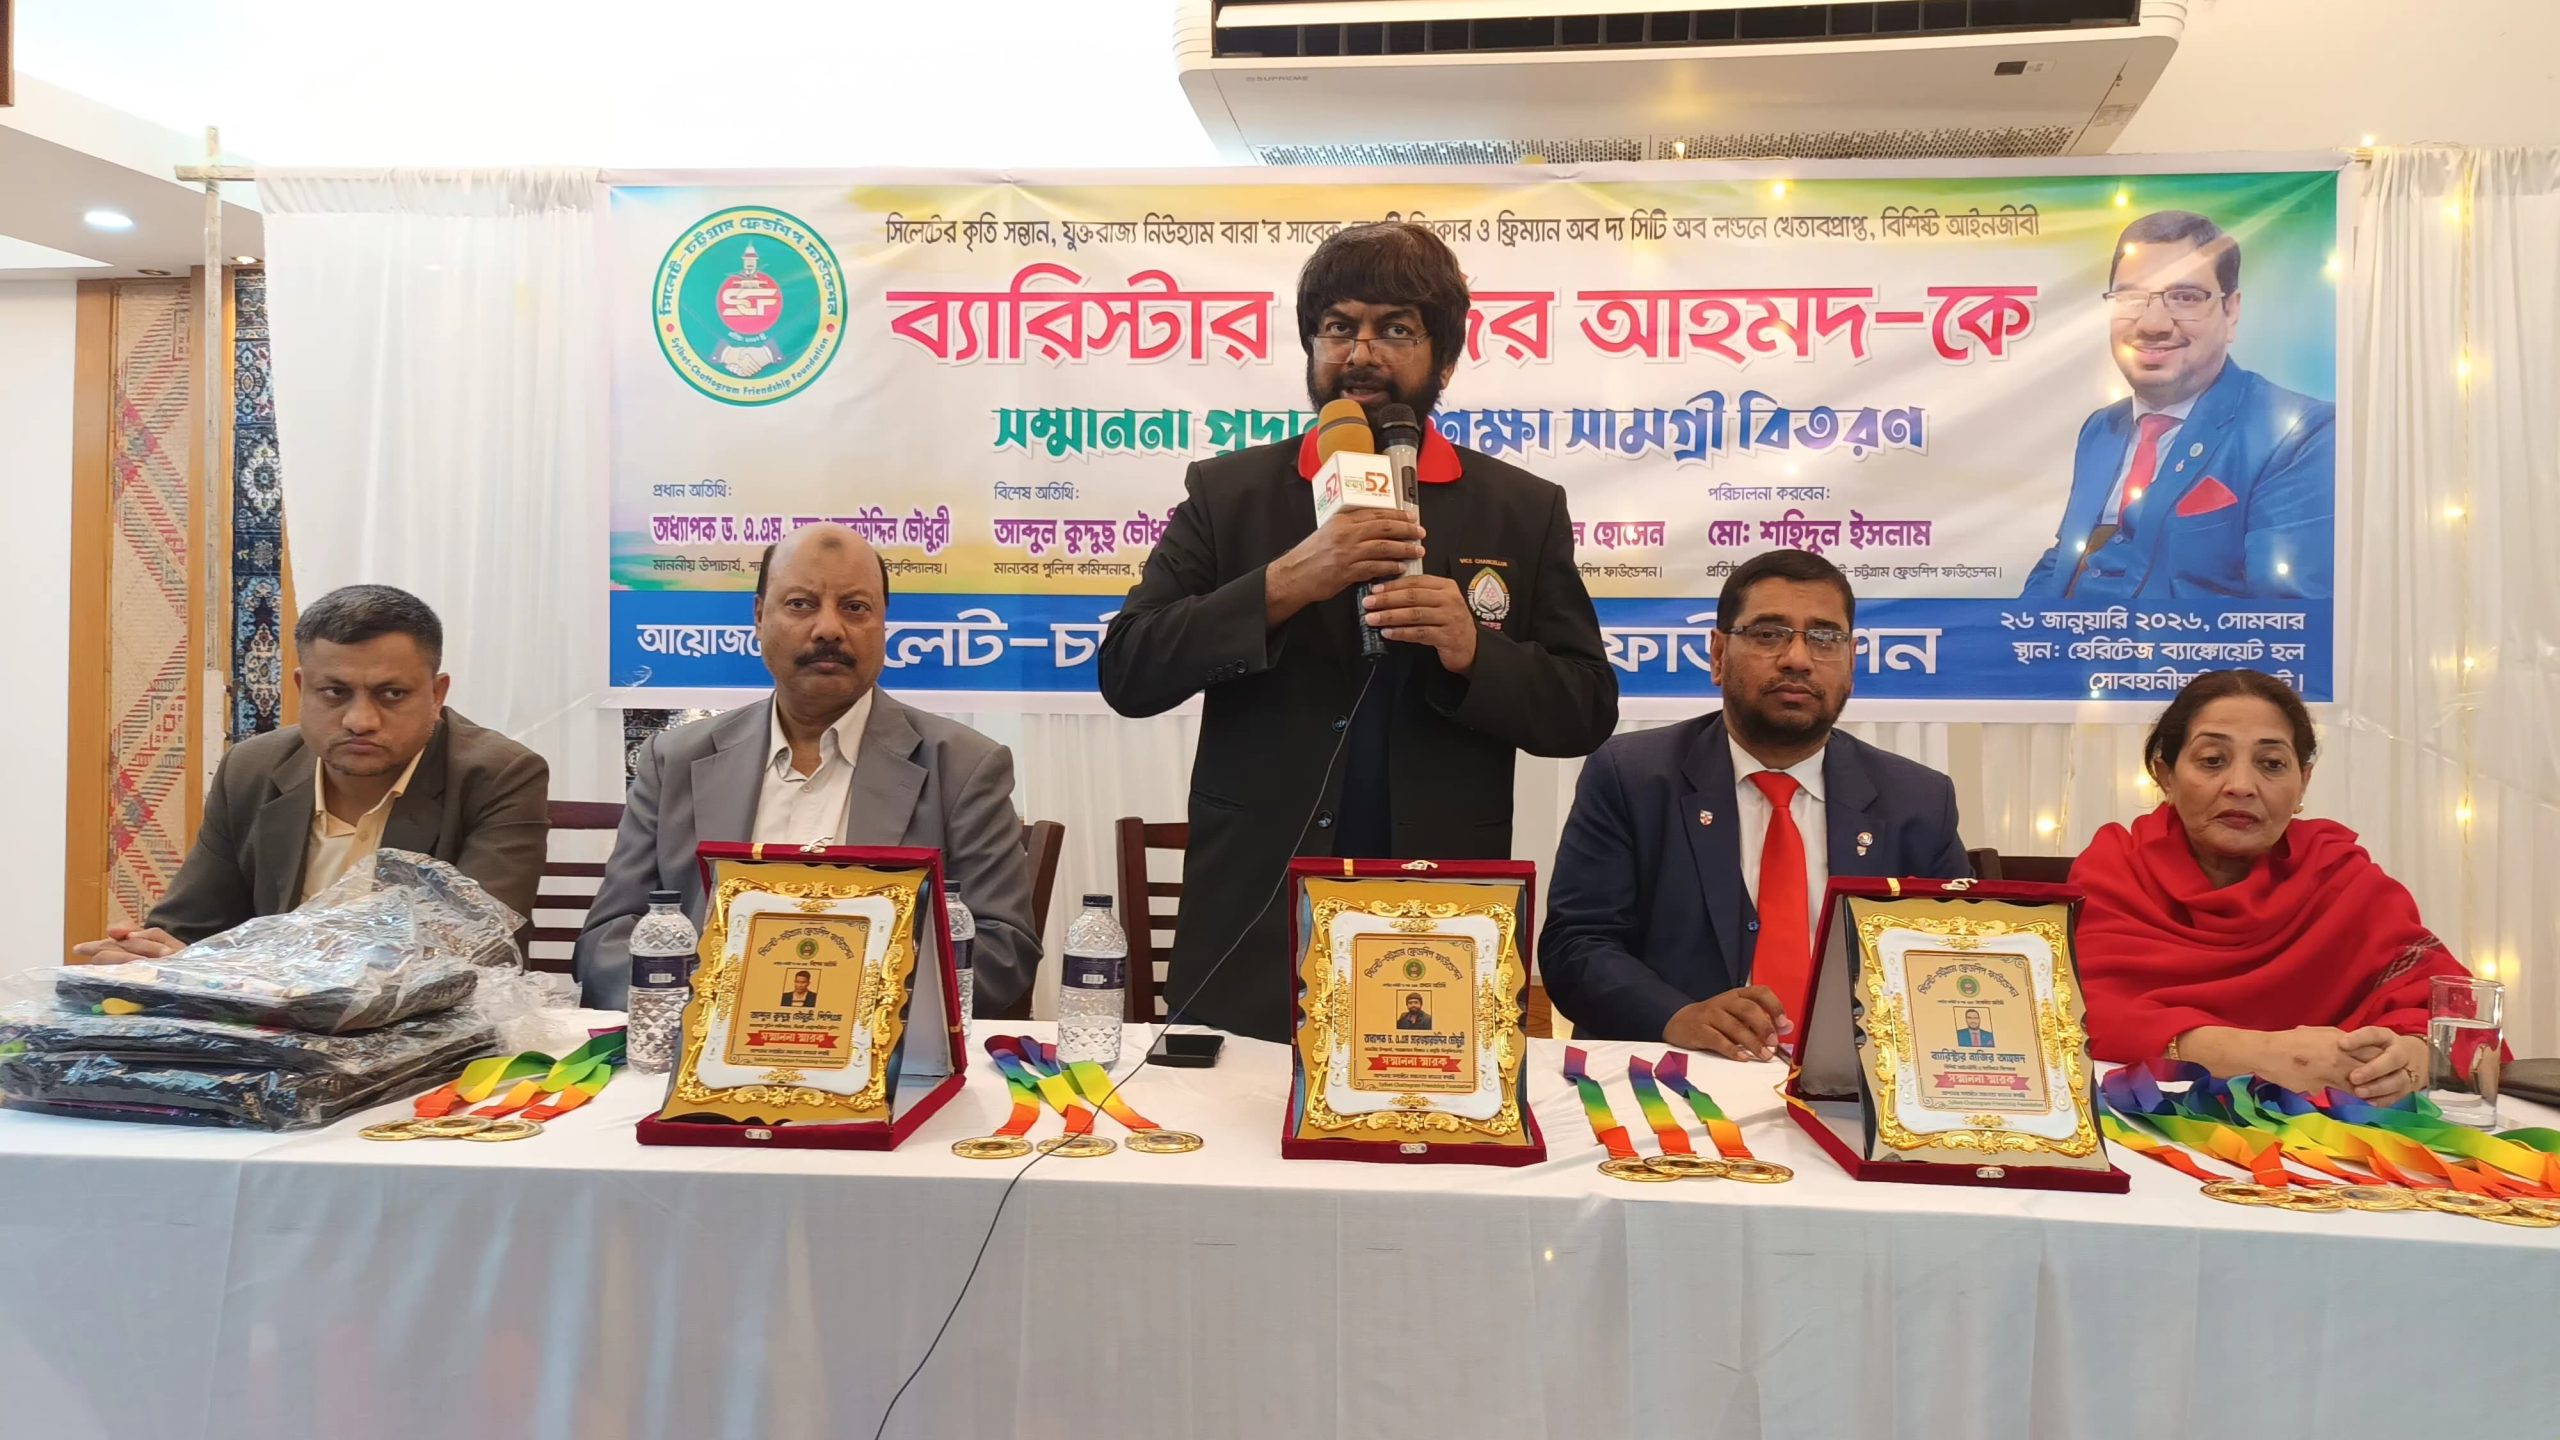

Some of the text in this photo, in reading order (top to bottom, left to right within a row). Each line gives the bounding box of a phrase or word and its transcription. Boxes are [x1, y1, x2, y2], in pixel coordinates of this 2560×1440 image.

[886, 212, 957, 244] সিলেটের
[963, 212, 998, 251] কৃতি
[1497, 209, 1560, 248] ফ্রিম্যান
[1566, 218, 1600, 241] অব
[1605, 217, 1625, 242] দ্য
[1631, 208, 1668, 241] সিটি
[1673, 218, 1707, 241] অব
[1881, 206, 1940, 237] বিশিষ্ট
[1945, 204, 2040, 238] আইনজীবী
[886, 262, 1275, 361] ব্যারিস্টার
[743, 379, 792, 395] Friendship
[791, 338, 829, 381] Foundation
[991, 406, 1193, 458] সম্মাননা
[1565, 389, 1732, 464] সামগ্রী
[1738, 389, 1926, 456] বিতরণ
[652, 483, 685, 498] প্রধান
[993, 481, 1032, 500] বিশেষ
[1365, 471, 1389, 493] 52
[1707, 486, 1772, 501] পরিচালনা
[653, 515, 717, 543] অধ্যাপক
[902, 504, 951, 553] চৌধুরী
[993, 519, 1058, 554] আব্দুল
[1063, 519, 1117, 555] কুদ্দুছ
[1593, 520, 1665, 547] হোসেন
[1759, 508, 1841, 554] শহিদুল
[1849, 509, 1932, 549] ইসলাম
[652, 556, 696, 573] মাননীয়
[993, 562, 1039, 575] মান্যবর
[1043, 558, 1074, 579] পুলিশ
[2001, 606, 2306, 635] ২৬ জানুয়ারি ২০২৬, সোমবার
[2068, 635, 2155, 661] হেরিটেজ
[2269, 642, 2306, 660] হল
